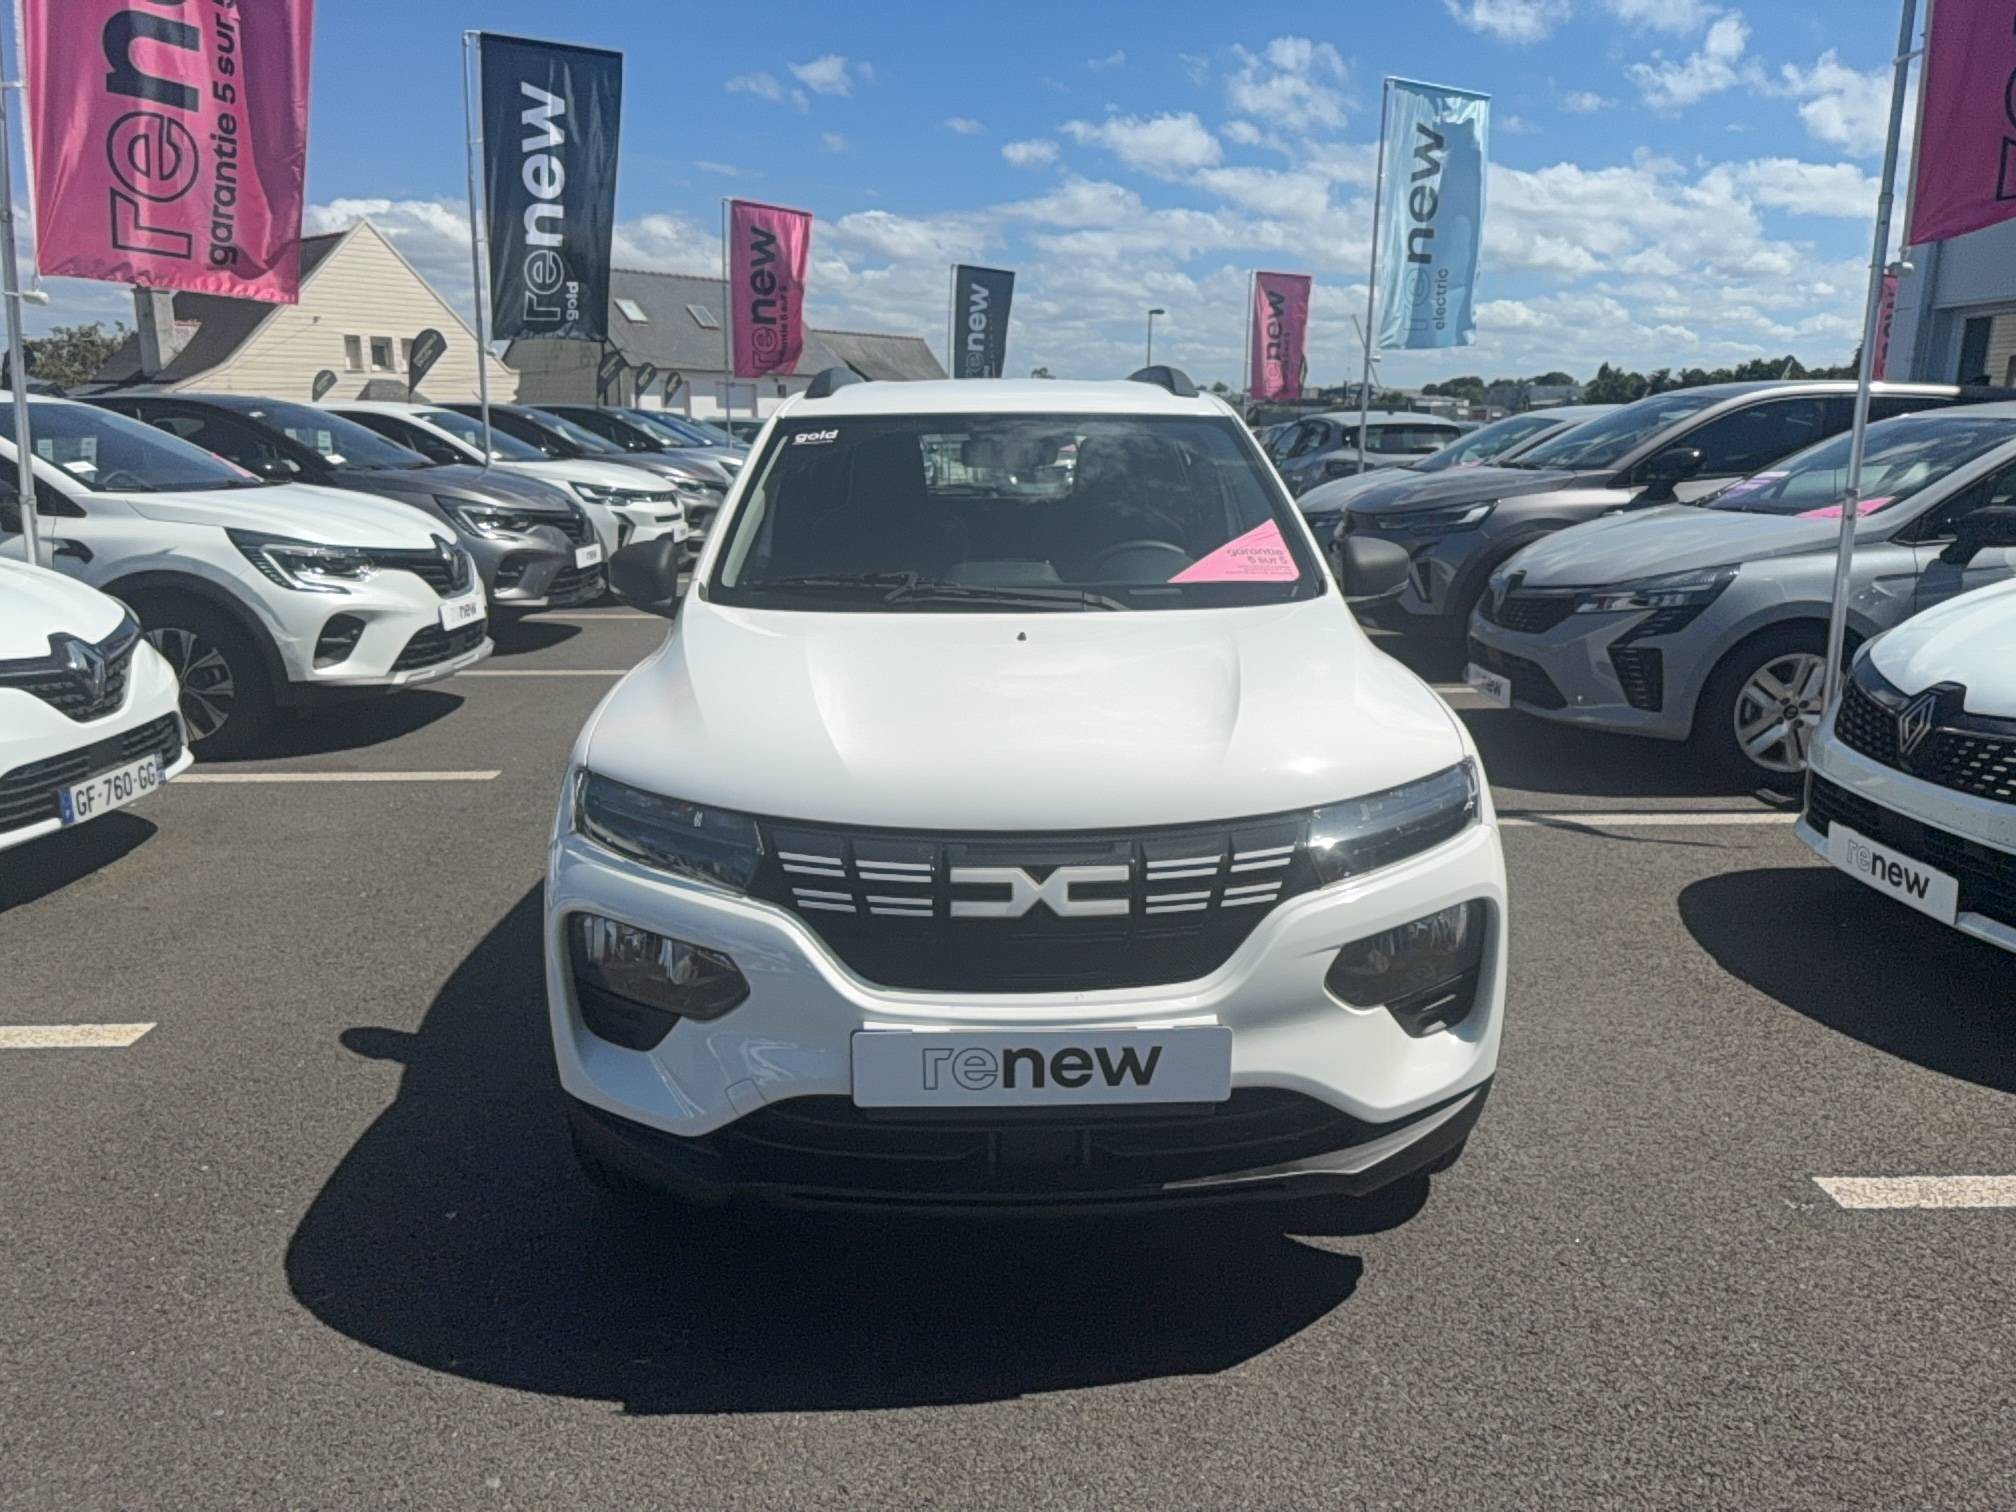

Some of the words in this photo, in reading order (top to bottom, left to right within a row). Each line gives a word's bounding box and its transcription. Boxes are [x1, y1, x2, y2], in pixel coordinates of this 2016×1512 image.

[215, 13, 236, 77] sur
[212, 80, 236, 105] 5
[208, 112, 238, 266] garantie
[519, 81, 566, 321] renew
[1402, 121, 1445, 331] renew
[565, 280, 580, 320] gold
[750, 225, 778, 369] renew
[1431, 267, 1449, 331] electric
[795, 429, 839, 443] gold
[75, 761, 156, 817] GF-760-GG
[1846, 839, 1931, 900] renew
[922, 1046, 1163, 1091] renew
